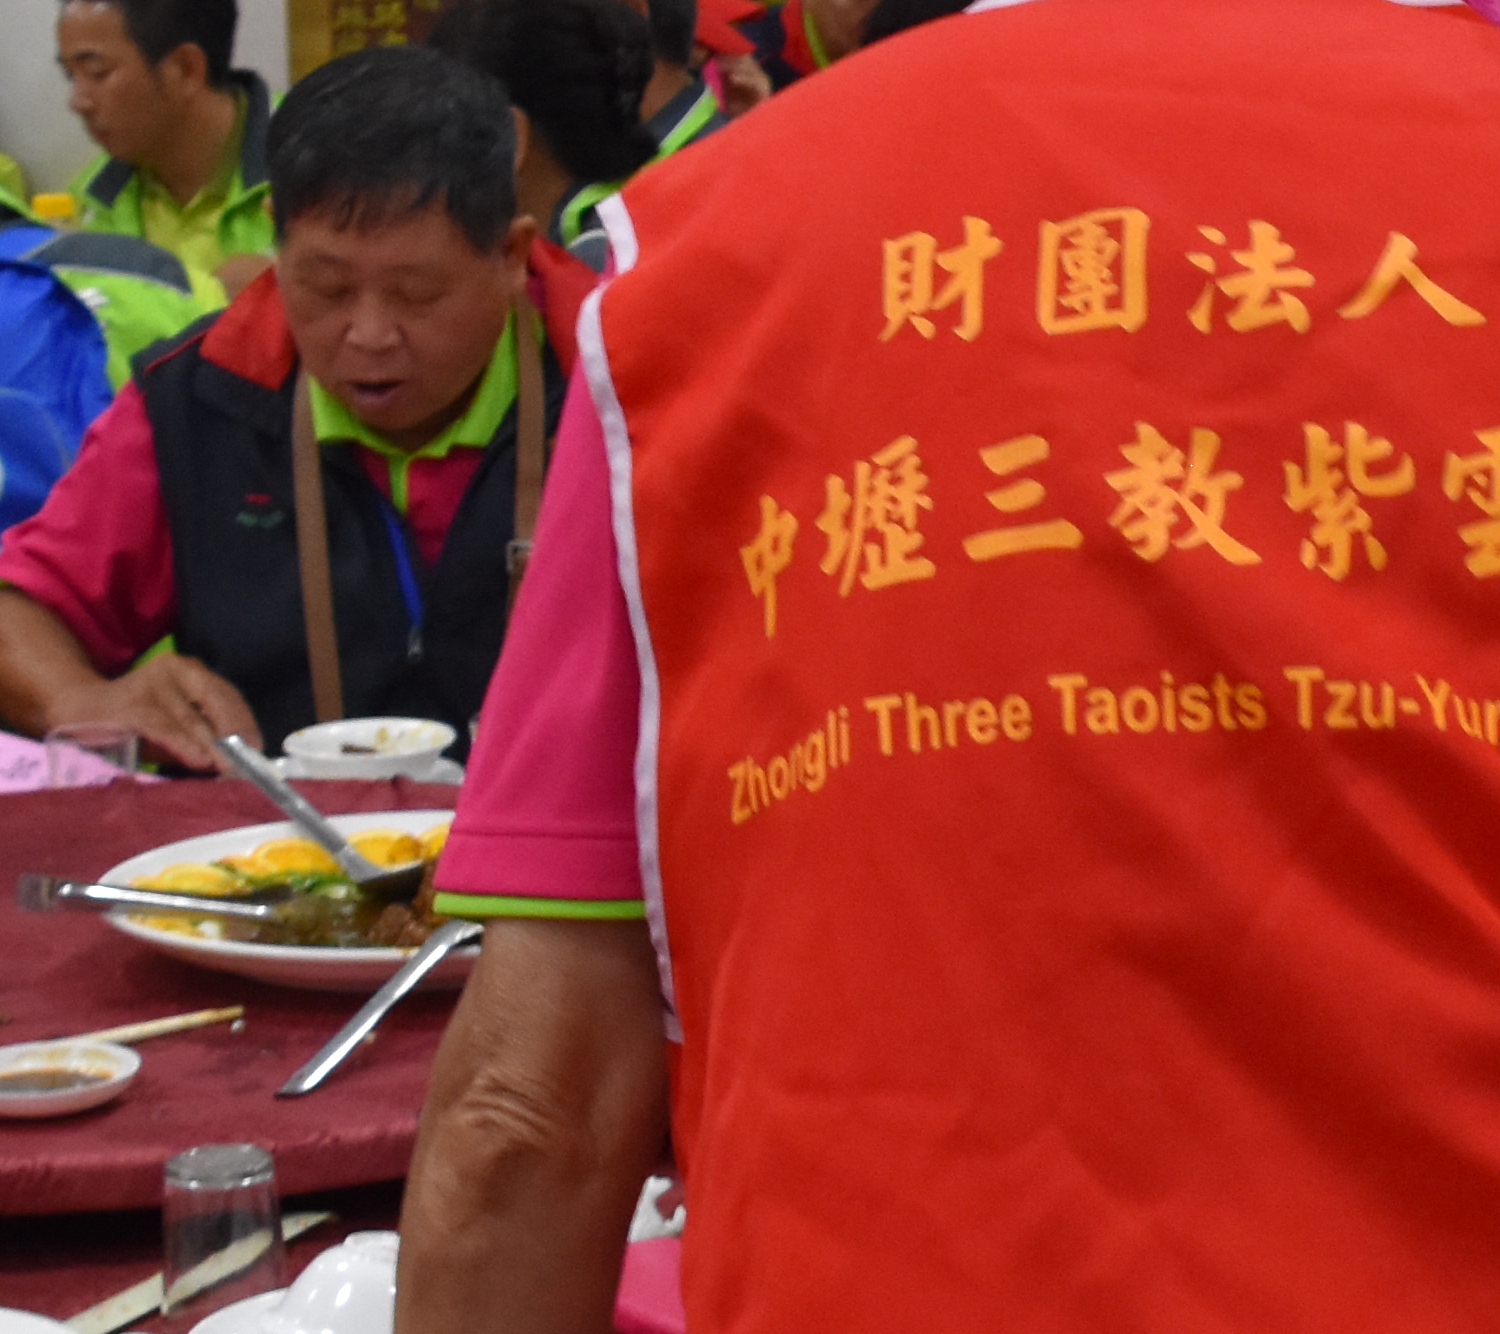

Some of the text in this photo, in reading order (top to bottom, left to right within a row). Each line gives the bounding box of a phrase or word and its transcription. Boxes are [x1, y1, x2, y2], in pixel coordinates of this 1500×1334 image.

[878, 205, 1488, 344] 財團法人
[727, 704, 850, 826] Zhongli
[863, 691, 1033, 757] Three
[1047, 670, 1267, 736] Taoists
